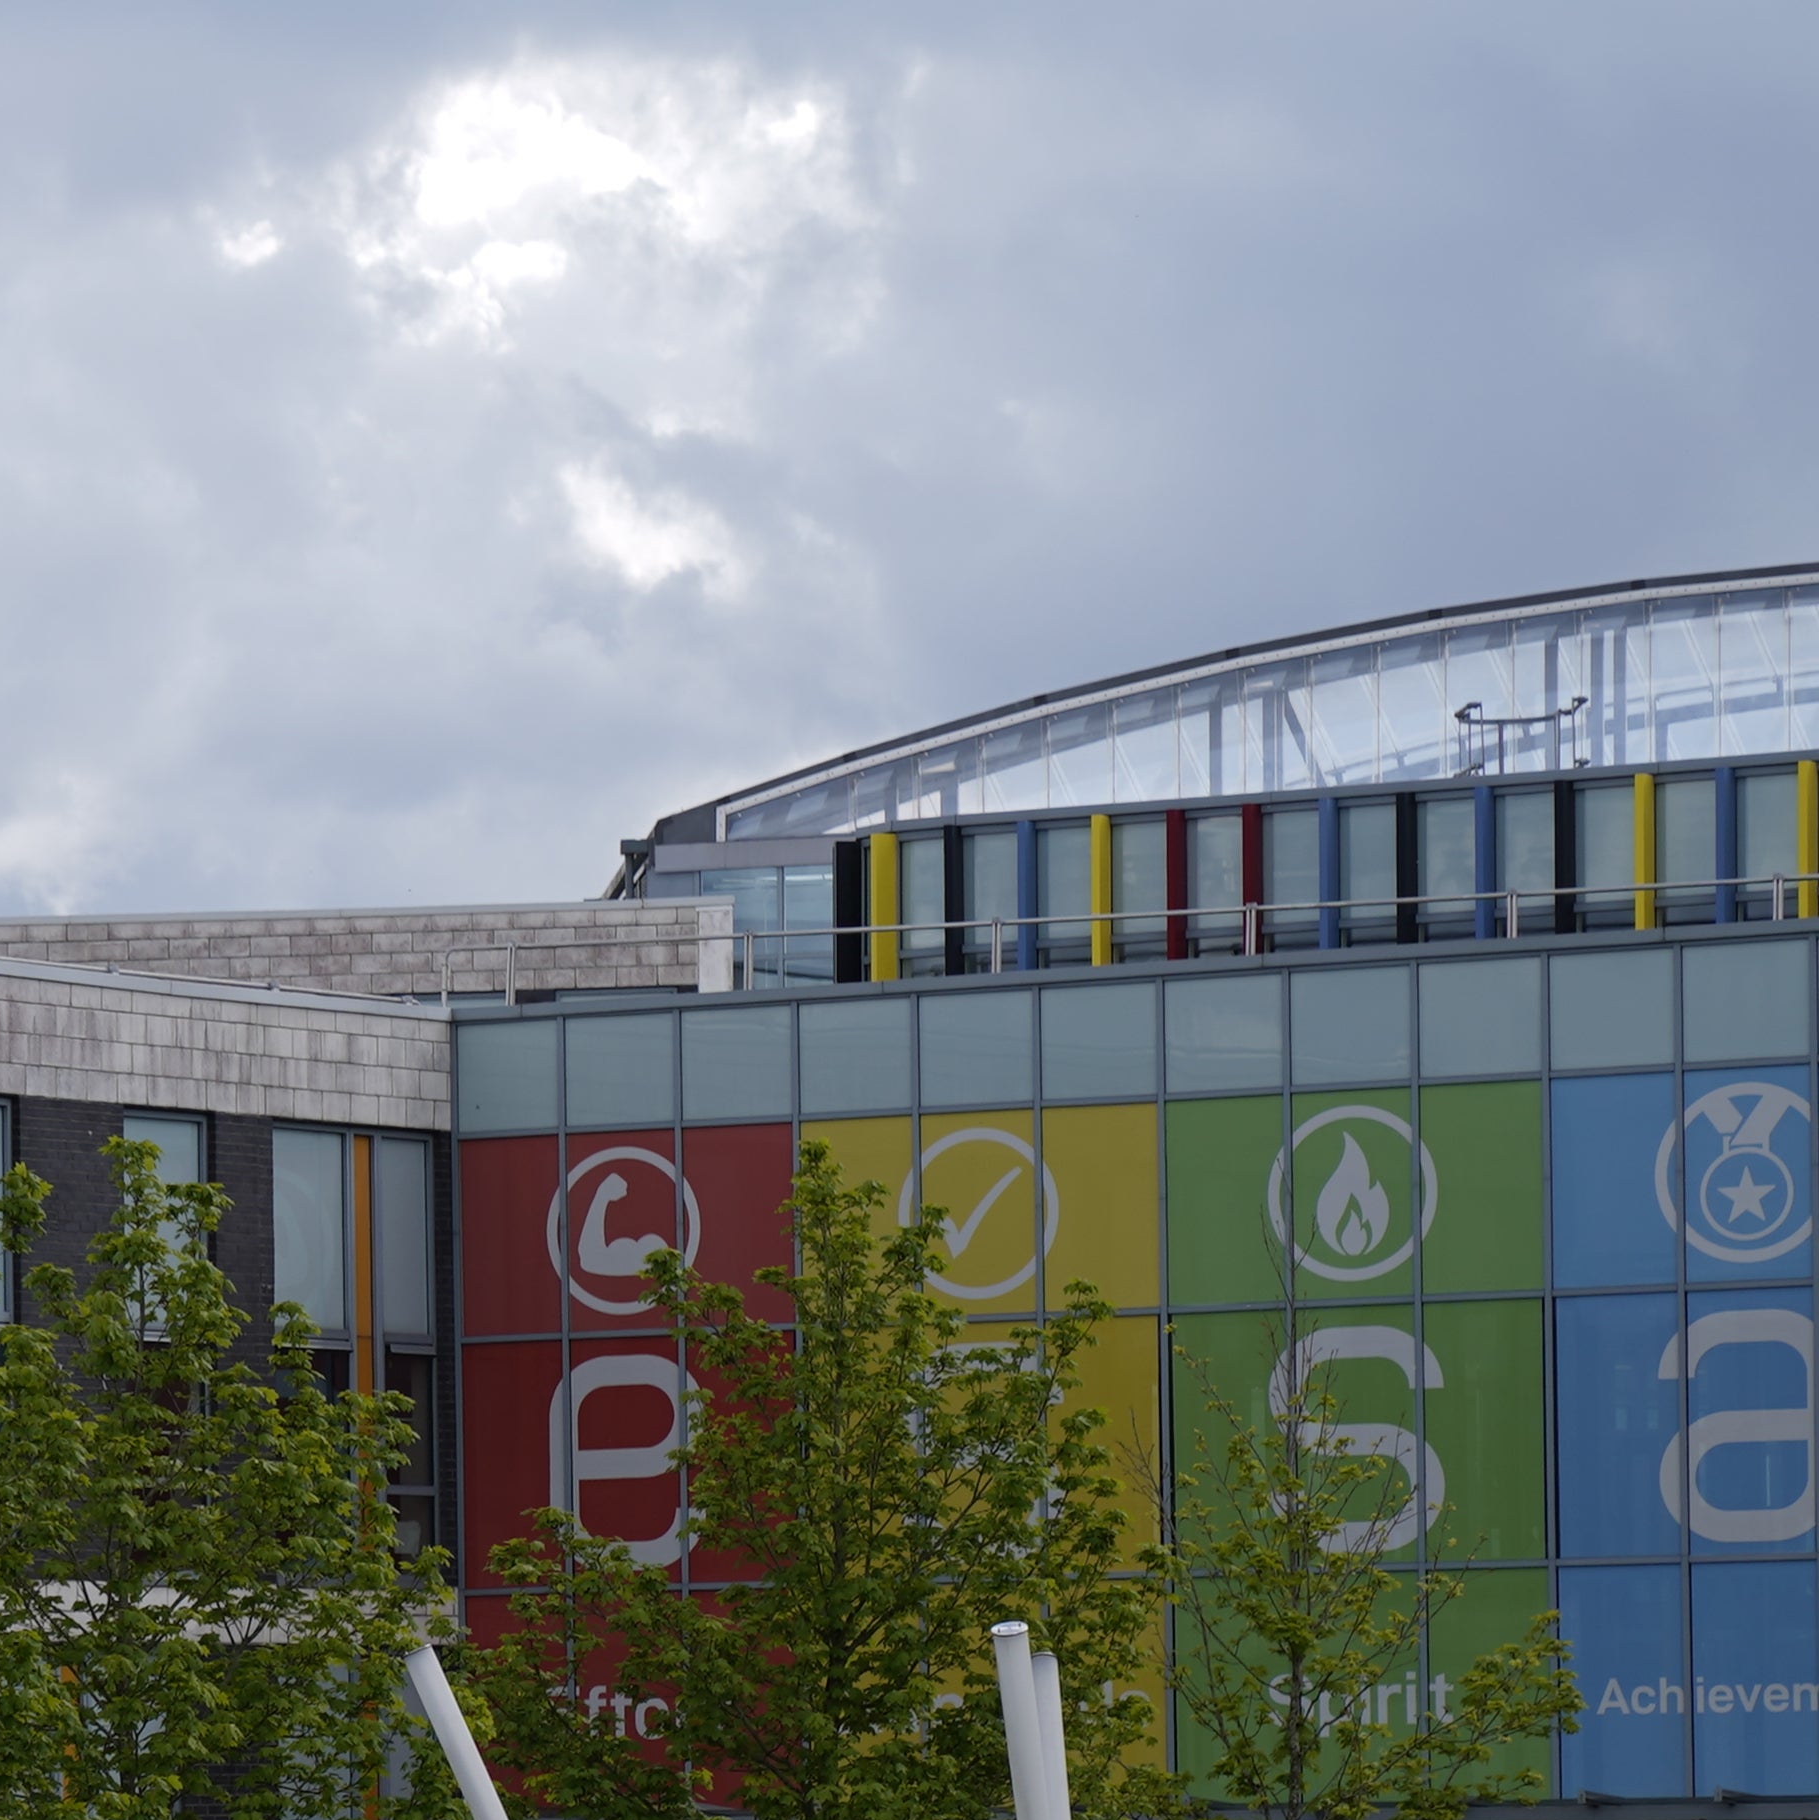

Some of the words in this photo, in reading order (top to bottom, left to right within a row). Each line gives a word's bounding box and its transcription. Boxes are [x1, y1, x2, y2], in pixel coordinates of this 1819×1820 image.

[1268, 1326, 1446, 1554] s
[1659, 1309, 1819, 1542] a
[1268, 1671, 1454, 1738] Spirit
